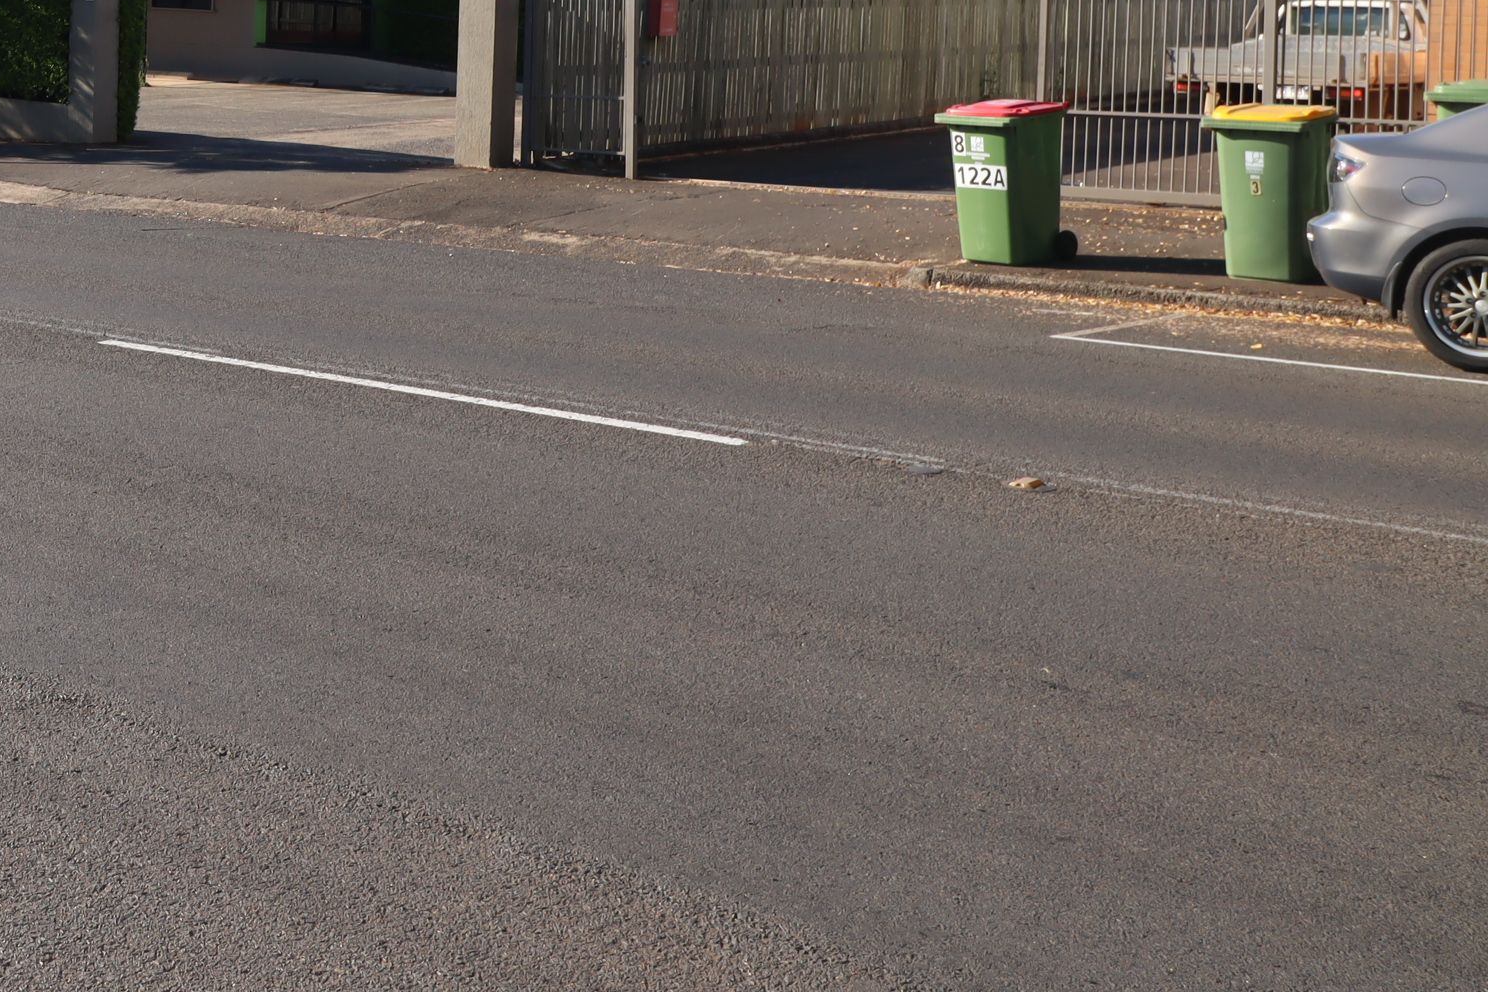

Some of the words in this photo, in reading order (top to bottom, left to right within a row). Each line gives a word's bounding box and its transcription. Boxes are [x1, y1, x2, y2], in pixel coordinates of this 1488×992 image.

[954, 135, 965, 153] 8
[958, 166, 1005, 187] 122A
[1252, 181, 1259, 193] 3
